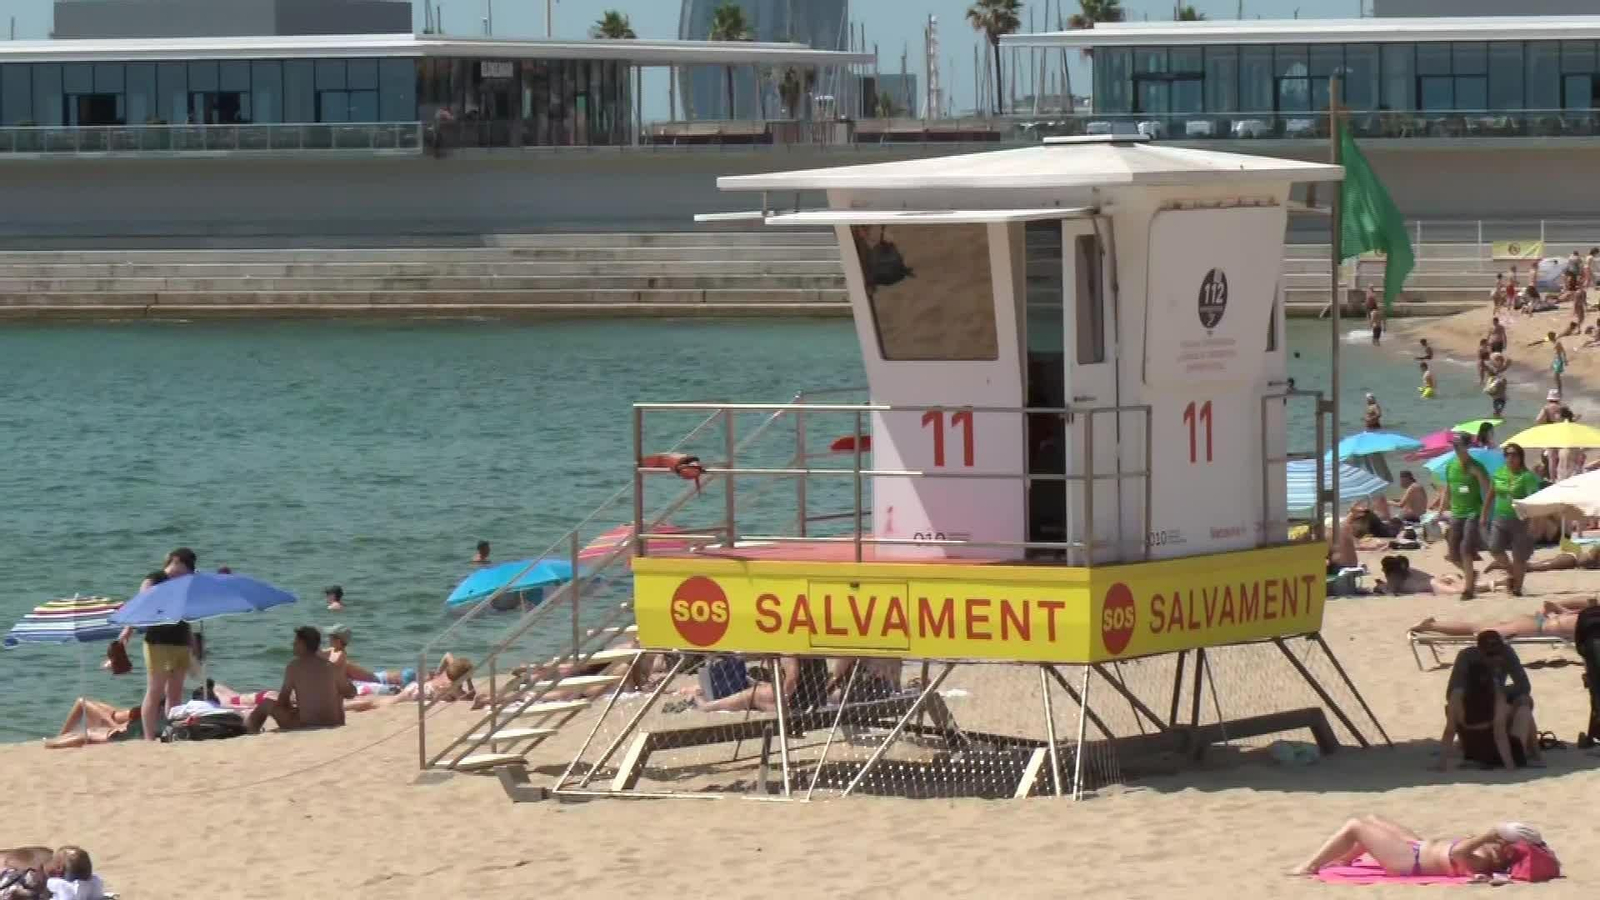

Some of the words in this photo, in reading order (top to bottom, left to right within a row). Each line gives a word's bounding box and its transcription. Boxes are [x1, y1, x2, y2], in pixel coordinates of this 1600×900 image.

[1204, 282, 1224, 305] 112
[921, 410, 974, 467] 11
[1183, 400, 1213, 463] 11
[673, 599, 729, 623] SOS
[755, 593, 1066, 643] SALVAMENT
[1103, 605, 1135, 632] SOS
[1149, 574, 1316, 635] SALVAMENT
